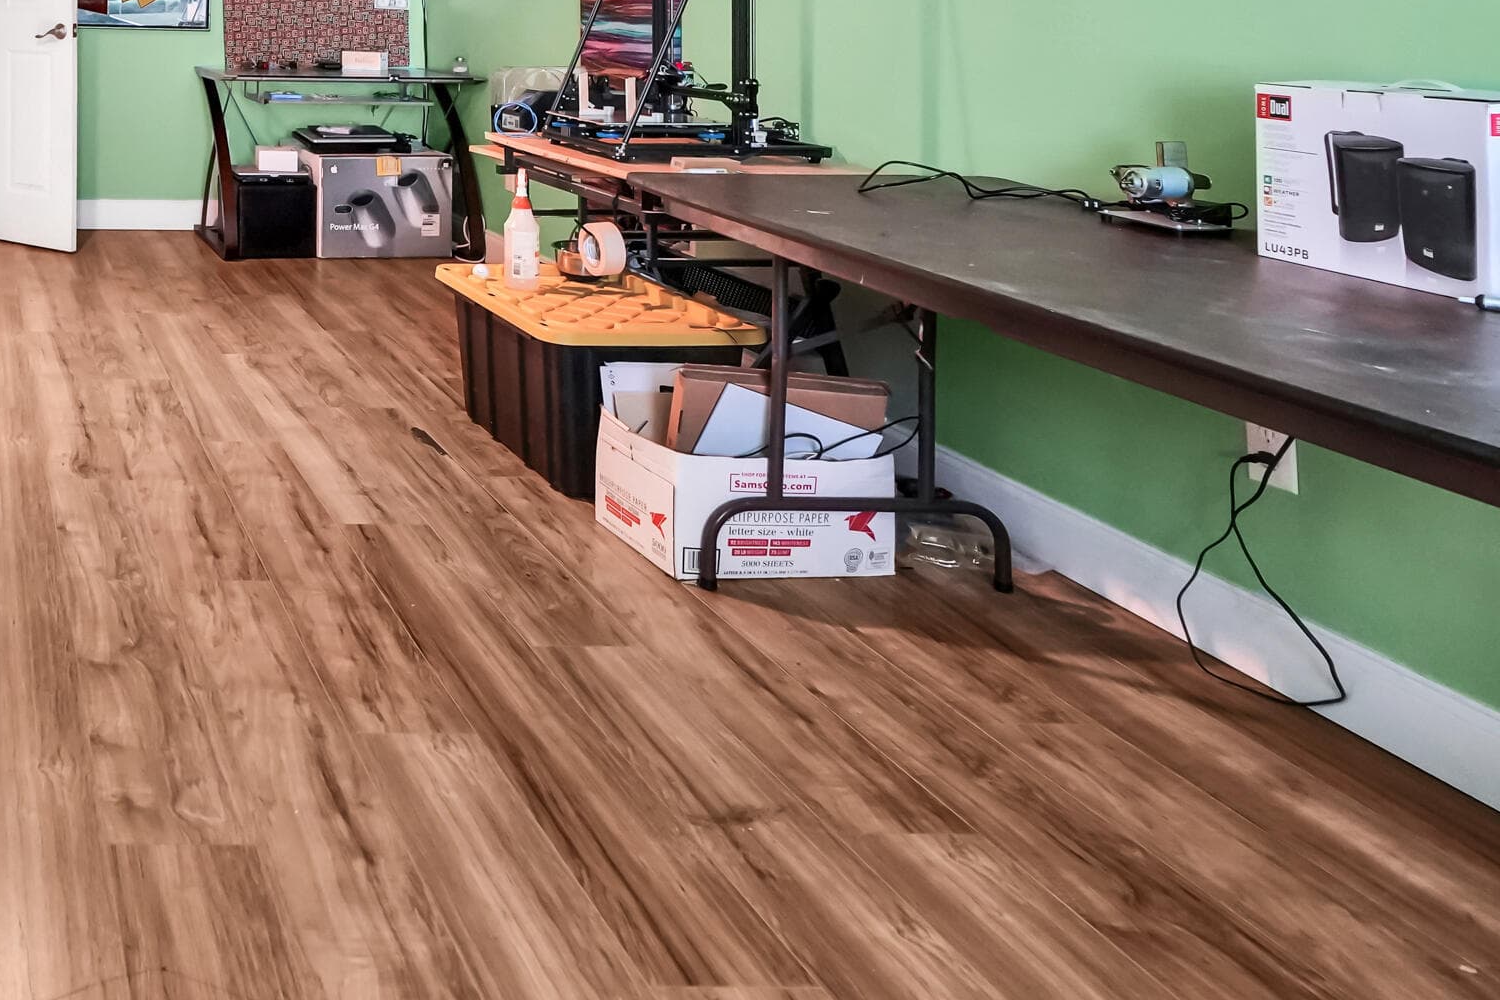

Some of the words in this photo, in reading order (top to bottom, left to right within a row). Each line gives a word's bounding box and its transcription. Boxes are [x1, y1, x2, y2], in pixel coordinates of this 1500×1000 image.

[1270, 99, 1289, 116] Dual
[329, 223, 352, 231] Power
[368, 223, 380, 231] G4
[1265, 242, 1309, 260] LU43PB
[798, 513, 830, 524] PAPER
[728, 527, 755, 536] letter
[757, 528, 777, 536] size
[787, 528, 814, 536] white
